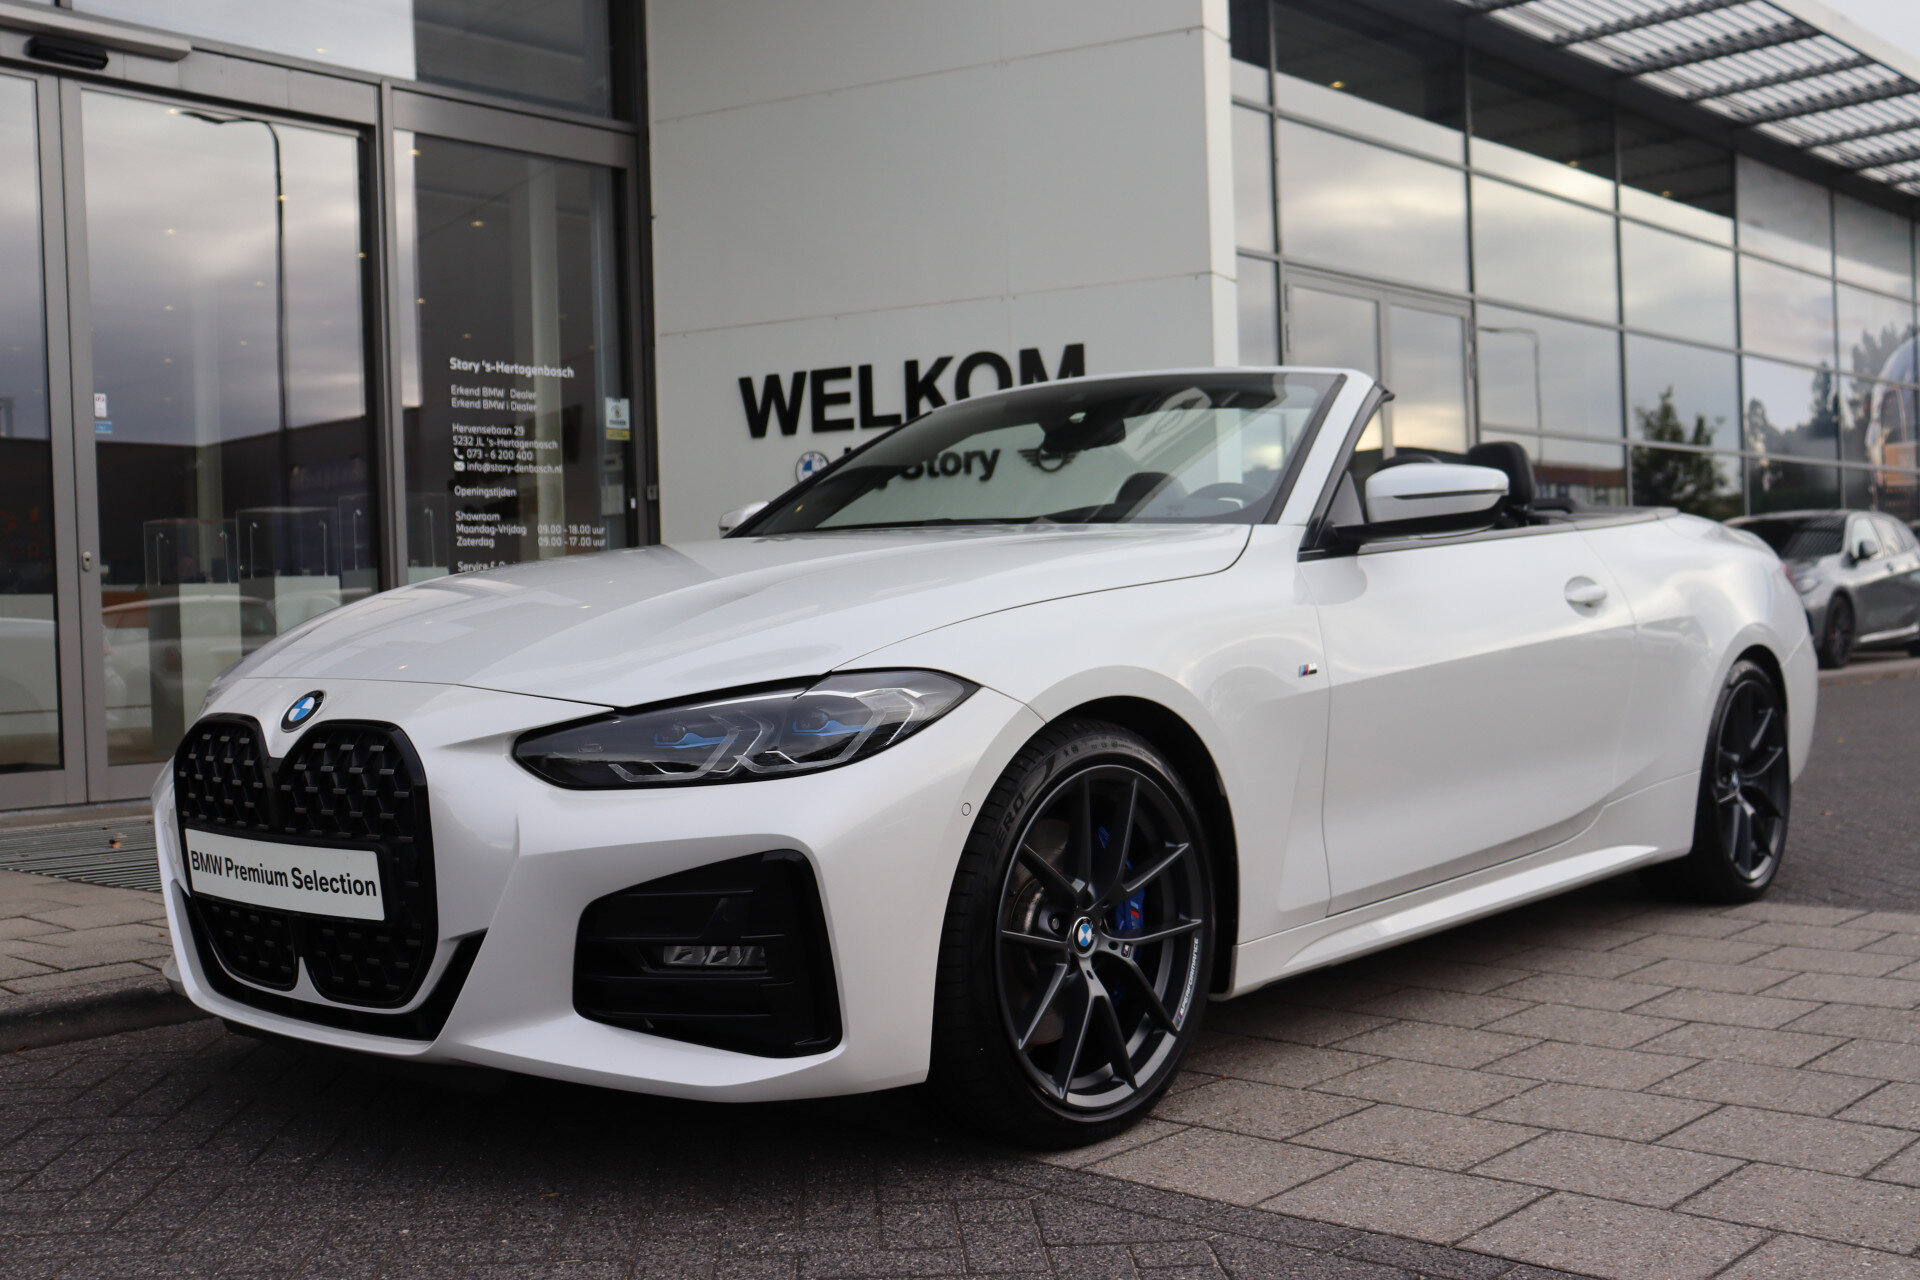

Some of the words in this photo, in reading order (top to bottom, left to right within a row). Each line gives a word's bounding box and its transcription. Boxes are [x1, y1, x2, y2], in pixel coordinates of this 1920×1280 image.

[449, 357, 479, 374] Story
[482, 360, 575, 378] 's-Hertogenbosch
[450, 384, 480, 397] Erkend
[482, 387, 505, 398] BMW
[510, 388, 537, 400] Dealer
[738, 343, 1086, 438] WELKOM
[451, 397, 480, 409] Erkend
[482, 399, 505, 410] BMW
[510, 401, 537, 412] Dealer
[452, 423, 512, 436] Hervensebaan
[514, 425, 525, 436] 29
[453, 435, 474, 446] 5232
[486, 438, 558, 450] 's-Hertogenbosch
[467, 448, 482, 459] 073
[490, 450, 496, 460] 6
[498, 450, 515, 460] 200
[516, 450, 534, 461] 400
[454, 485, 517, 498] Openingstijden
[455, 511, 500, 521] Showroom
[456, 523, 528, 536] Maandag-Vrijdag
[537, 524, 562, 534] 09.00
[569, 524, 590, 534] 18.00
[592, 526, 606, 534] uur
[457, 536, 495, 549] Zaterdag
[538, 536, 562, 547] 09.00
[592, 538, 606, 547] uur
[191, 850, 222, 876] BMW
[225, 857, 289, 888] Premium
[291, 867, 377, 897] Selection
